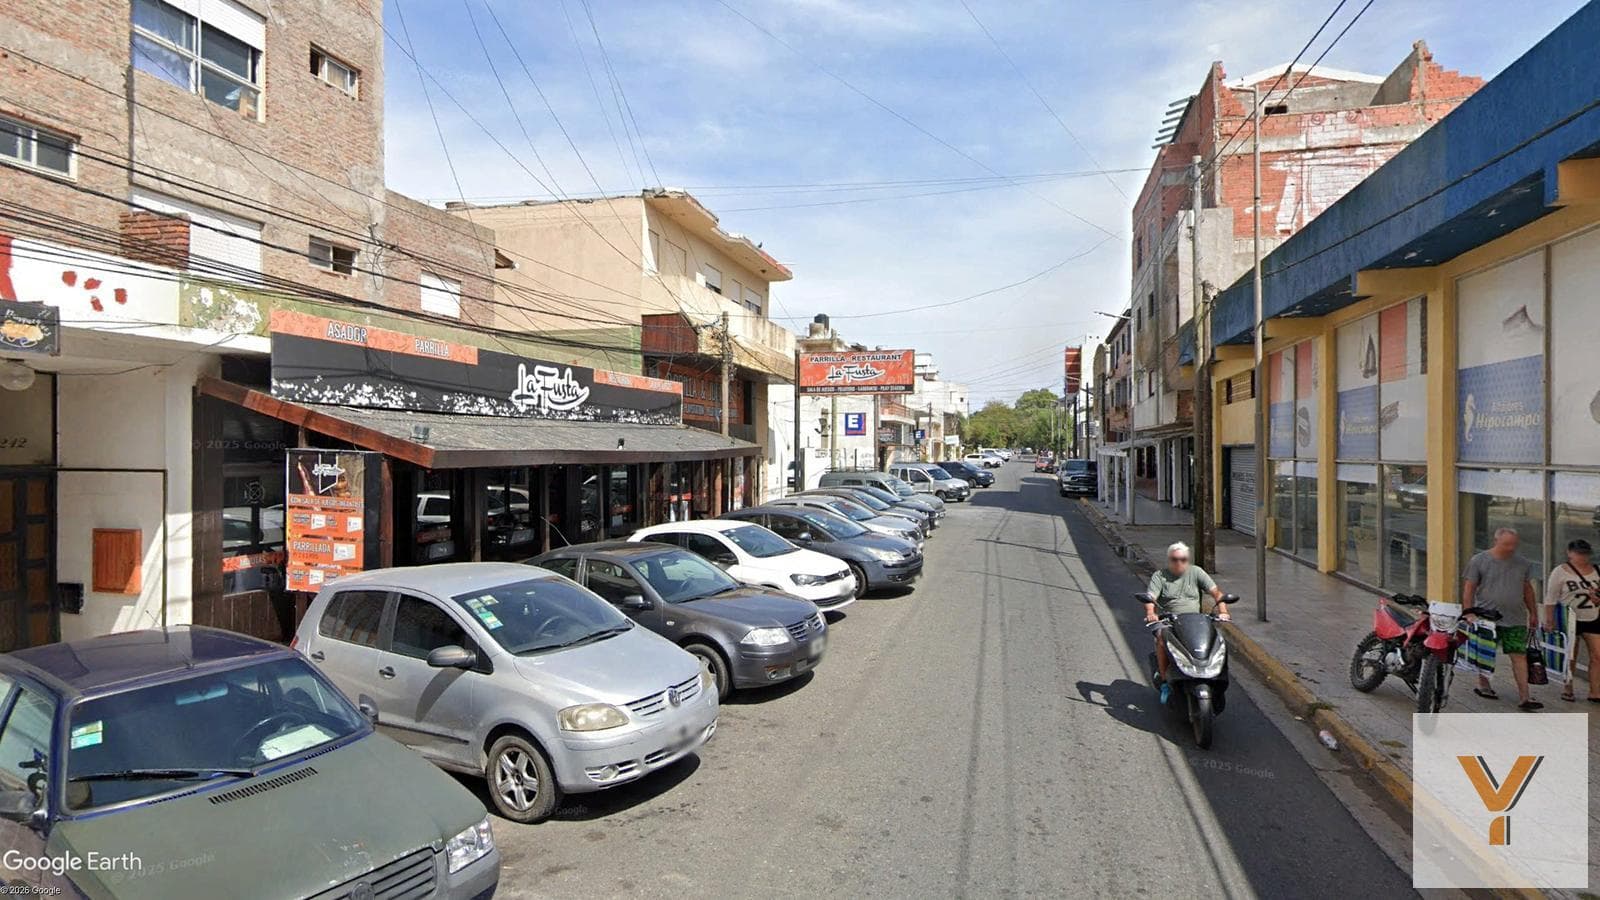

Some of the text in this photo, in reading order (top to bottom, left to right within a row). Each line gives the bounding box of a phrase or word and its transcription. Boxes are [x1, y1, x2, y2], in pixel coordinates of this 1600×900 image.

[327, 321, 367, 344] ASADOR
[415, 338, 449, 357] PARRILLA
[827, 364, 885, 382] La Fusta
[513, 364, 590, 414] La Fusta
[848, 414, 859, 429] E
[1476, 412, 1540, 431] Hipocampo
